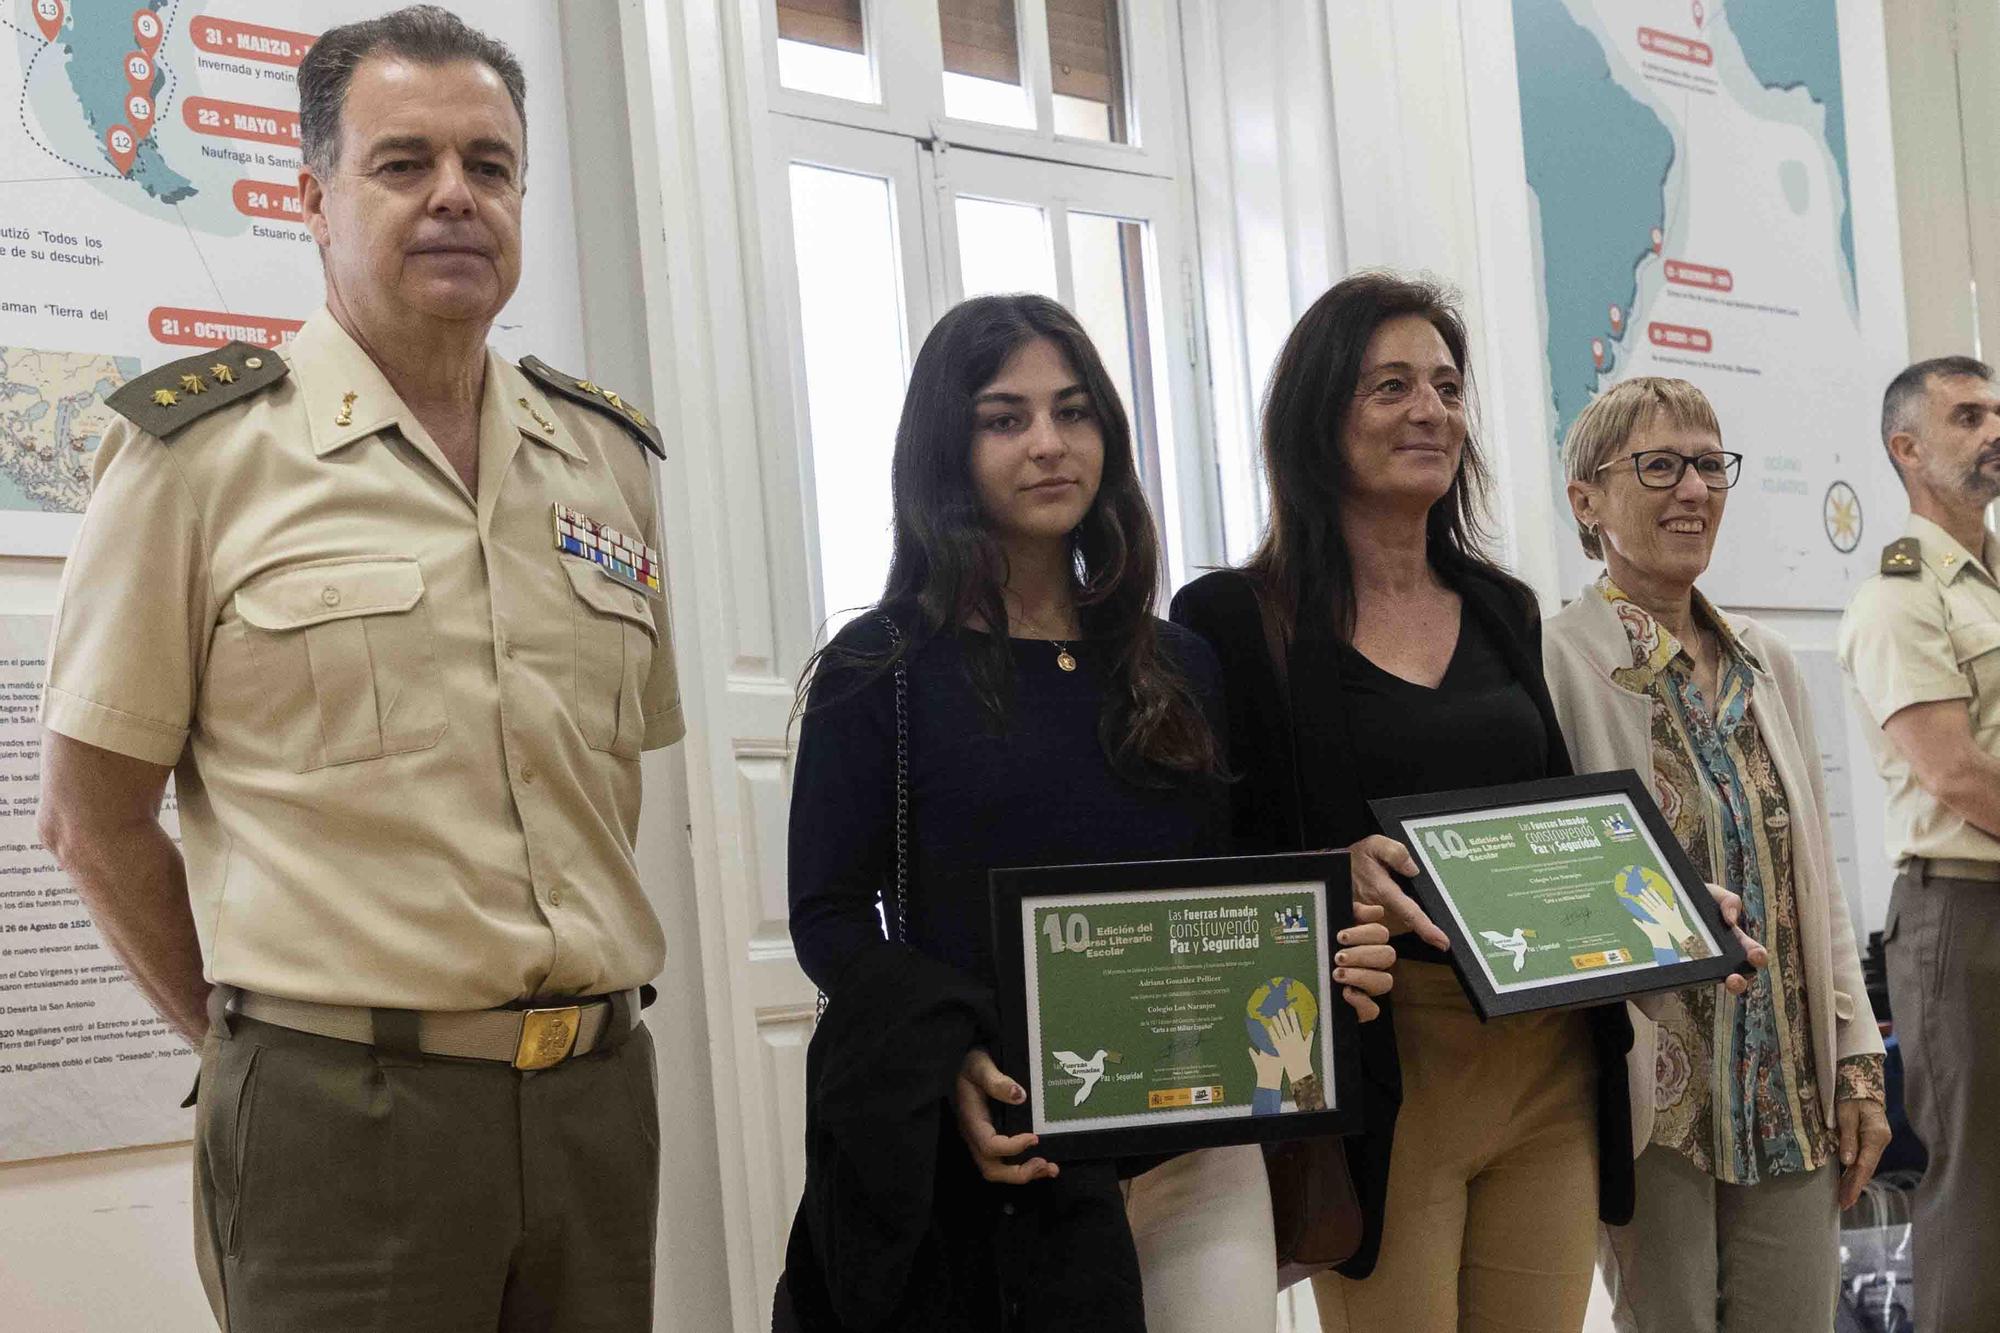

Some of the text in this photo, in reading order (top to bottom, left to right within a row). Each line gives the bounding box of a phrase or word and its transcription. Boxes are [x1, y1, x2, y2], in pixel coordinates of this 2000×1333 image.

[40, 4, 57, 16] 13
[142, 20, 151, 31] 9
[205, 28, 223, 45] 31
[237, 33, 291, 57] MARZO
[132, 65, 146, 76] 10
[198, 57, 252, 76] Invernada
[254, 67, 261, 79] y
[133, 103, 149, 115] 11
[198, 108, 277, 135] 22 MAYO
[114, 136, 130, 149] 12
[201, 146, 252, 164] Naufraga
[255, 154, 265, 165] la
[247, 191, 269, 209] 24
[252, 225, 312, 243] Estuario de
[85, 235, 103, 249] los
[11, 245, 26, 257] de
[31, 249, 45, 260] su
[50, 250, 104, 266] descubri-
[90, 309, 108, 321] del
[161, 319, 268, 344] 21 OCTUBRE
[11, 658, 19, 666] el
[21, 658, 45, 667] puerto
[1525, 823, 1596, 844] construyendo
[1425, 829, 1470, 860] 10
[1530, 842, 1549, 854] Paz
[1548, 843, 1557, 854] y
[1555, 836, 1601, 852] Seguridad
[1168, 905, 1258, 921] Las Fuerzas Armadas
[5, 924, 17, 933] 26
[18, 924, 28, 932] de
[30, 922, 57, 932] Agosto
[59, 921, 69, 930] de
[70, 920, 92, 929] 1520
[1043, 912, 1090, 954] 10
[1096, 923, 1153, 936] Edición del
[1169, 915, 1260, 939] construyendo
[1109, 933, 1153, 946] Literario
[1170, 939, 1190, 954] Paz
[1193, 942, 1199, 955] y
[1202, 934, 1260, 953] Seguridad
[2, 948, 12, 956] de
[14, 947, 38, 956] nuevo
[39, 944, 72, 954] elevaron
[1086, 947, 1125, 958] Escolar
[9, 970, 17, 978] el
[18, 969, 39, 978] Cabo
[1139, 979, 1165, 987] Adriana
[7, 1004, 38, 1014] Deserta
[40, 1003, 47, 1011] la
[49, 1002, 64, 1010] San
[66, 1000, 96, 1009] Antonio
[1147, 1005, 1173, 1014] Colegio
[17, 1026, 61, 1037] Magallanes
[97, 1019, 130, 1030] Estrecho
[24, 1039, 36, 1047] del
[66, 1035, 79, 1045] por
[94, 1030, 124, 1041] muchos
[125, 1028, 150, 1039] fuegos
[16, 1060, 60, 1072] Magallanes
[85, 1056, 92, 1064] el
[93, 1054, 113, 1064] Cabo
[172, 1047, 192, 1056] Cabo
[1072, 1067, 1101, 1075] Armadas
[1115, 1071, 1144, 1082] Seguridad
